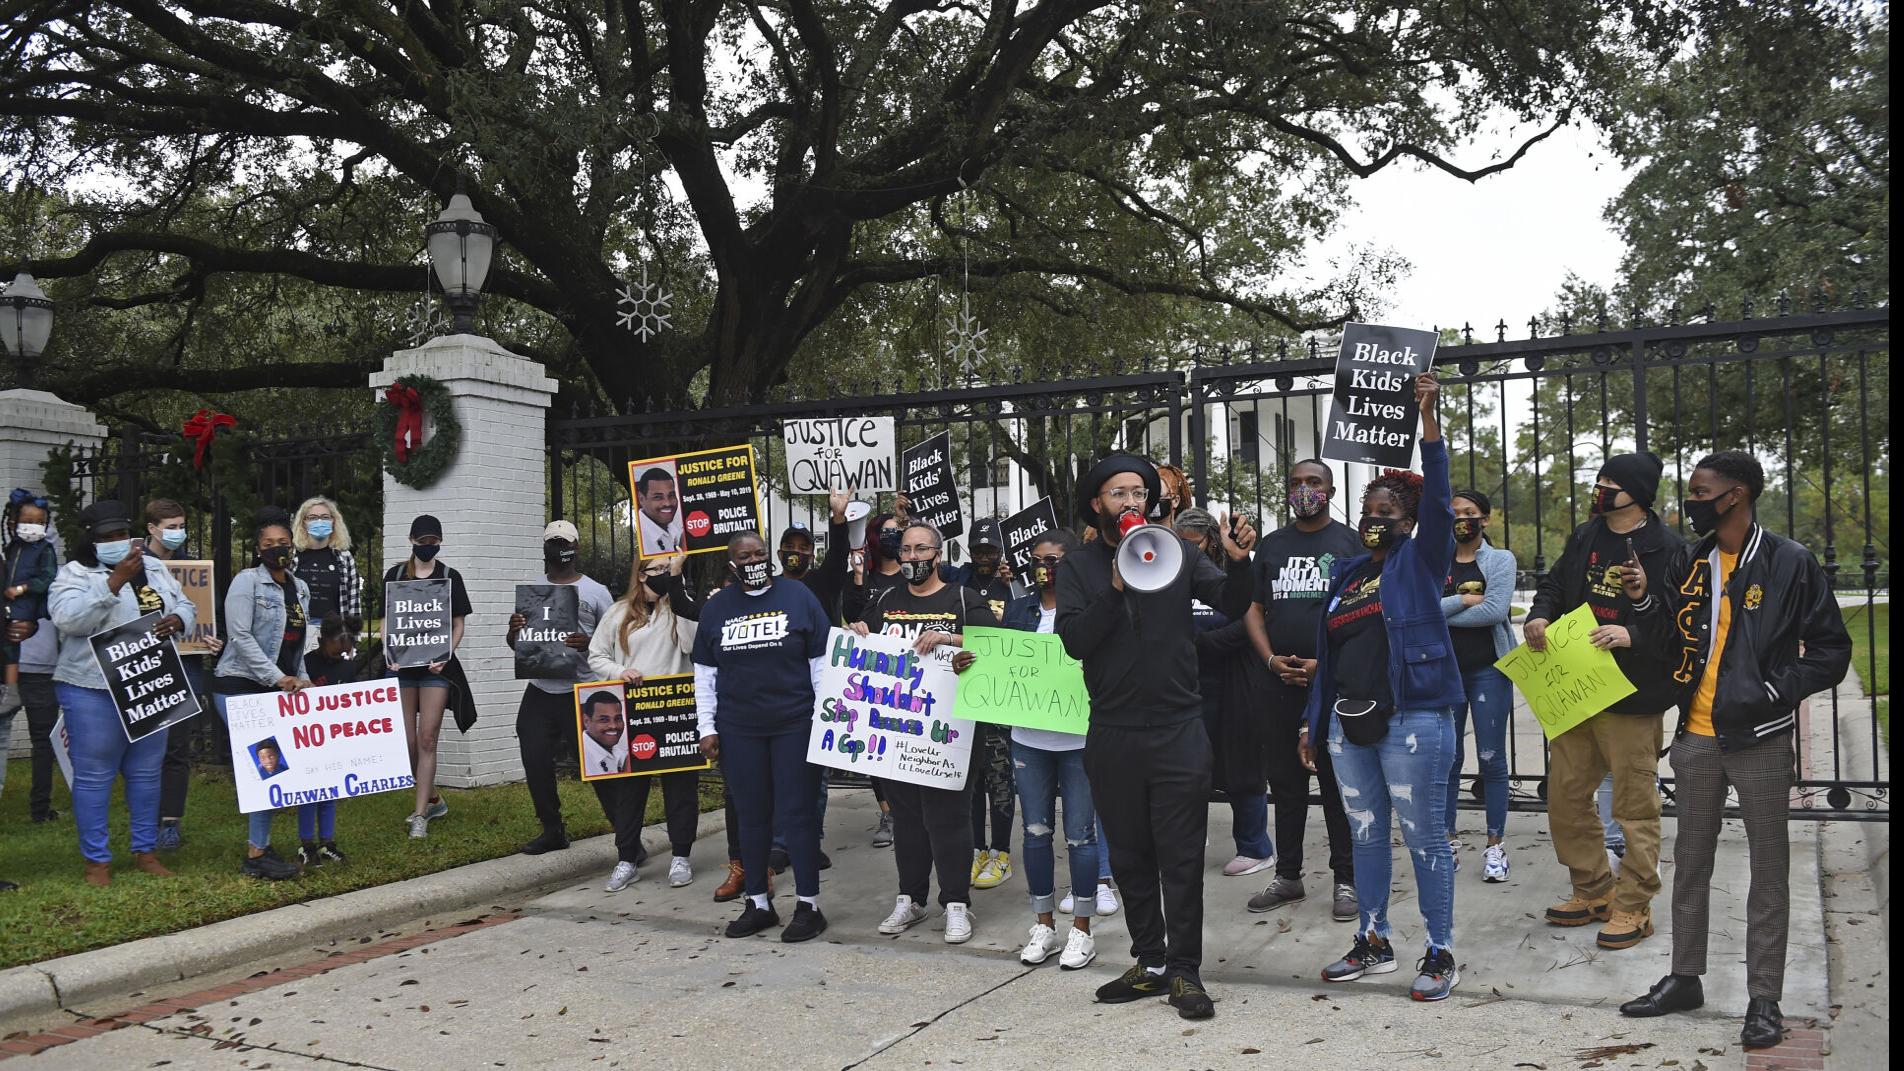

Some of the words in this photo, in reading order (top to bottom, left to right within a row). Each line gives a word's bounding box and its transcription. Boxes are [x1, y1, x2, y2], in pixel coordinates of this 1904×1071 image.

[1352, 342, 1418, 366] Black
[1350, 368, 1410, 392] Kids'
[1346, 395, 1406, 420] Lives
[1332, 420, 1410, 448] Matter
[814, 447, 842, 459] FOR
[678, 458, 723, 475] JUSTICE
[726, 456, 748, 468] FOR
[908, 448, 942, 476] Black
[688, 475, 716, 487] RONALD
[718, 471, 746, 482] GREENE
[793, 456, 892, 492] QUAWAN
[908, 468, 942, 494] Kids'
[720, 490, 730, 498] May
[912, 490, 949, 512] Lives
[718, 506, 747, 520] POLICE
[687, 518, 709, 530] STOP
[713, 518, 756, 535] BRUTALITY
[1008, 517, 1048, 548] Black
[744, 562, 768, 573] BLACK
[1288, 557, 1315, 568] IT'S
[748, 571, 767, 580] LIVES
[1280, 567, 1309, 580] NOT
[1310, 567, 1320, 580] A
[1272, 579, 1330, 592] MOMENT
[394, 599, 444, 614] Black
[543, 606, 551, 620] I
[396, 616, 441, 630] Lives
[725, 615, 748, 626] NAACP
[728, 620, 779, 640] VOTE!
[105, 631, 161, 662] Black
[388, 632, 448, 647] Matter
[115, 650, 163, 681] Kids'
[1009, 666, 1039, 678] FOR
[1545, 664, 1570, 688] FOR
[125, 673, 174, 701] Lives
[626, 685, 673, 699] JUSTICE
[963, 673, 1084, 718] QUAWAN
[278, 691, 310, 717] NO
[315, 686, 398, 711] JUSTICE
[635, 700, 664, 711] RONALD
[667, 698, 695, 708] GREENE
[1535, 666, 1608, 726] QUAWAN
[125, 690, 187, 724] Matter
[820, 697, 858, 733] Stop
[931, 719, 959, 744] Ur
[292, 724, 325, 749] NO
[330, 717, 393, 739] PEACE
[665, 731, 695, 744] POLICE
[821, 729, 834, 751] A
[632, 742, 655, 753] STOP
[659, 743, 701, 758] BRUTALIT
[900, 753, 941, 765] Neighbor
[942, 759, 955, 768] As
